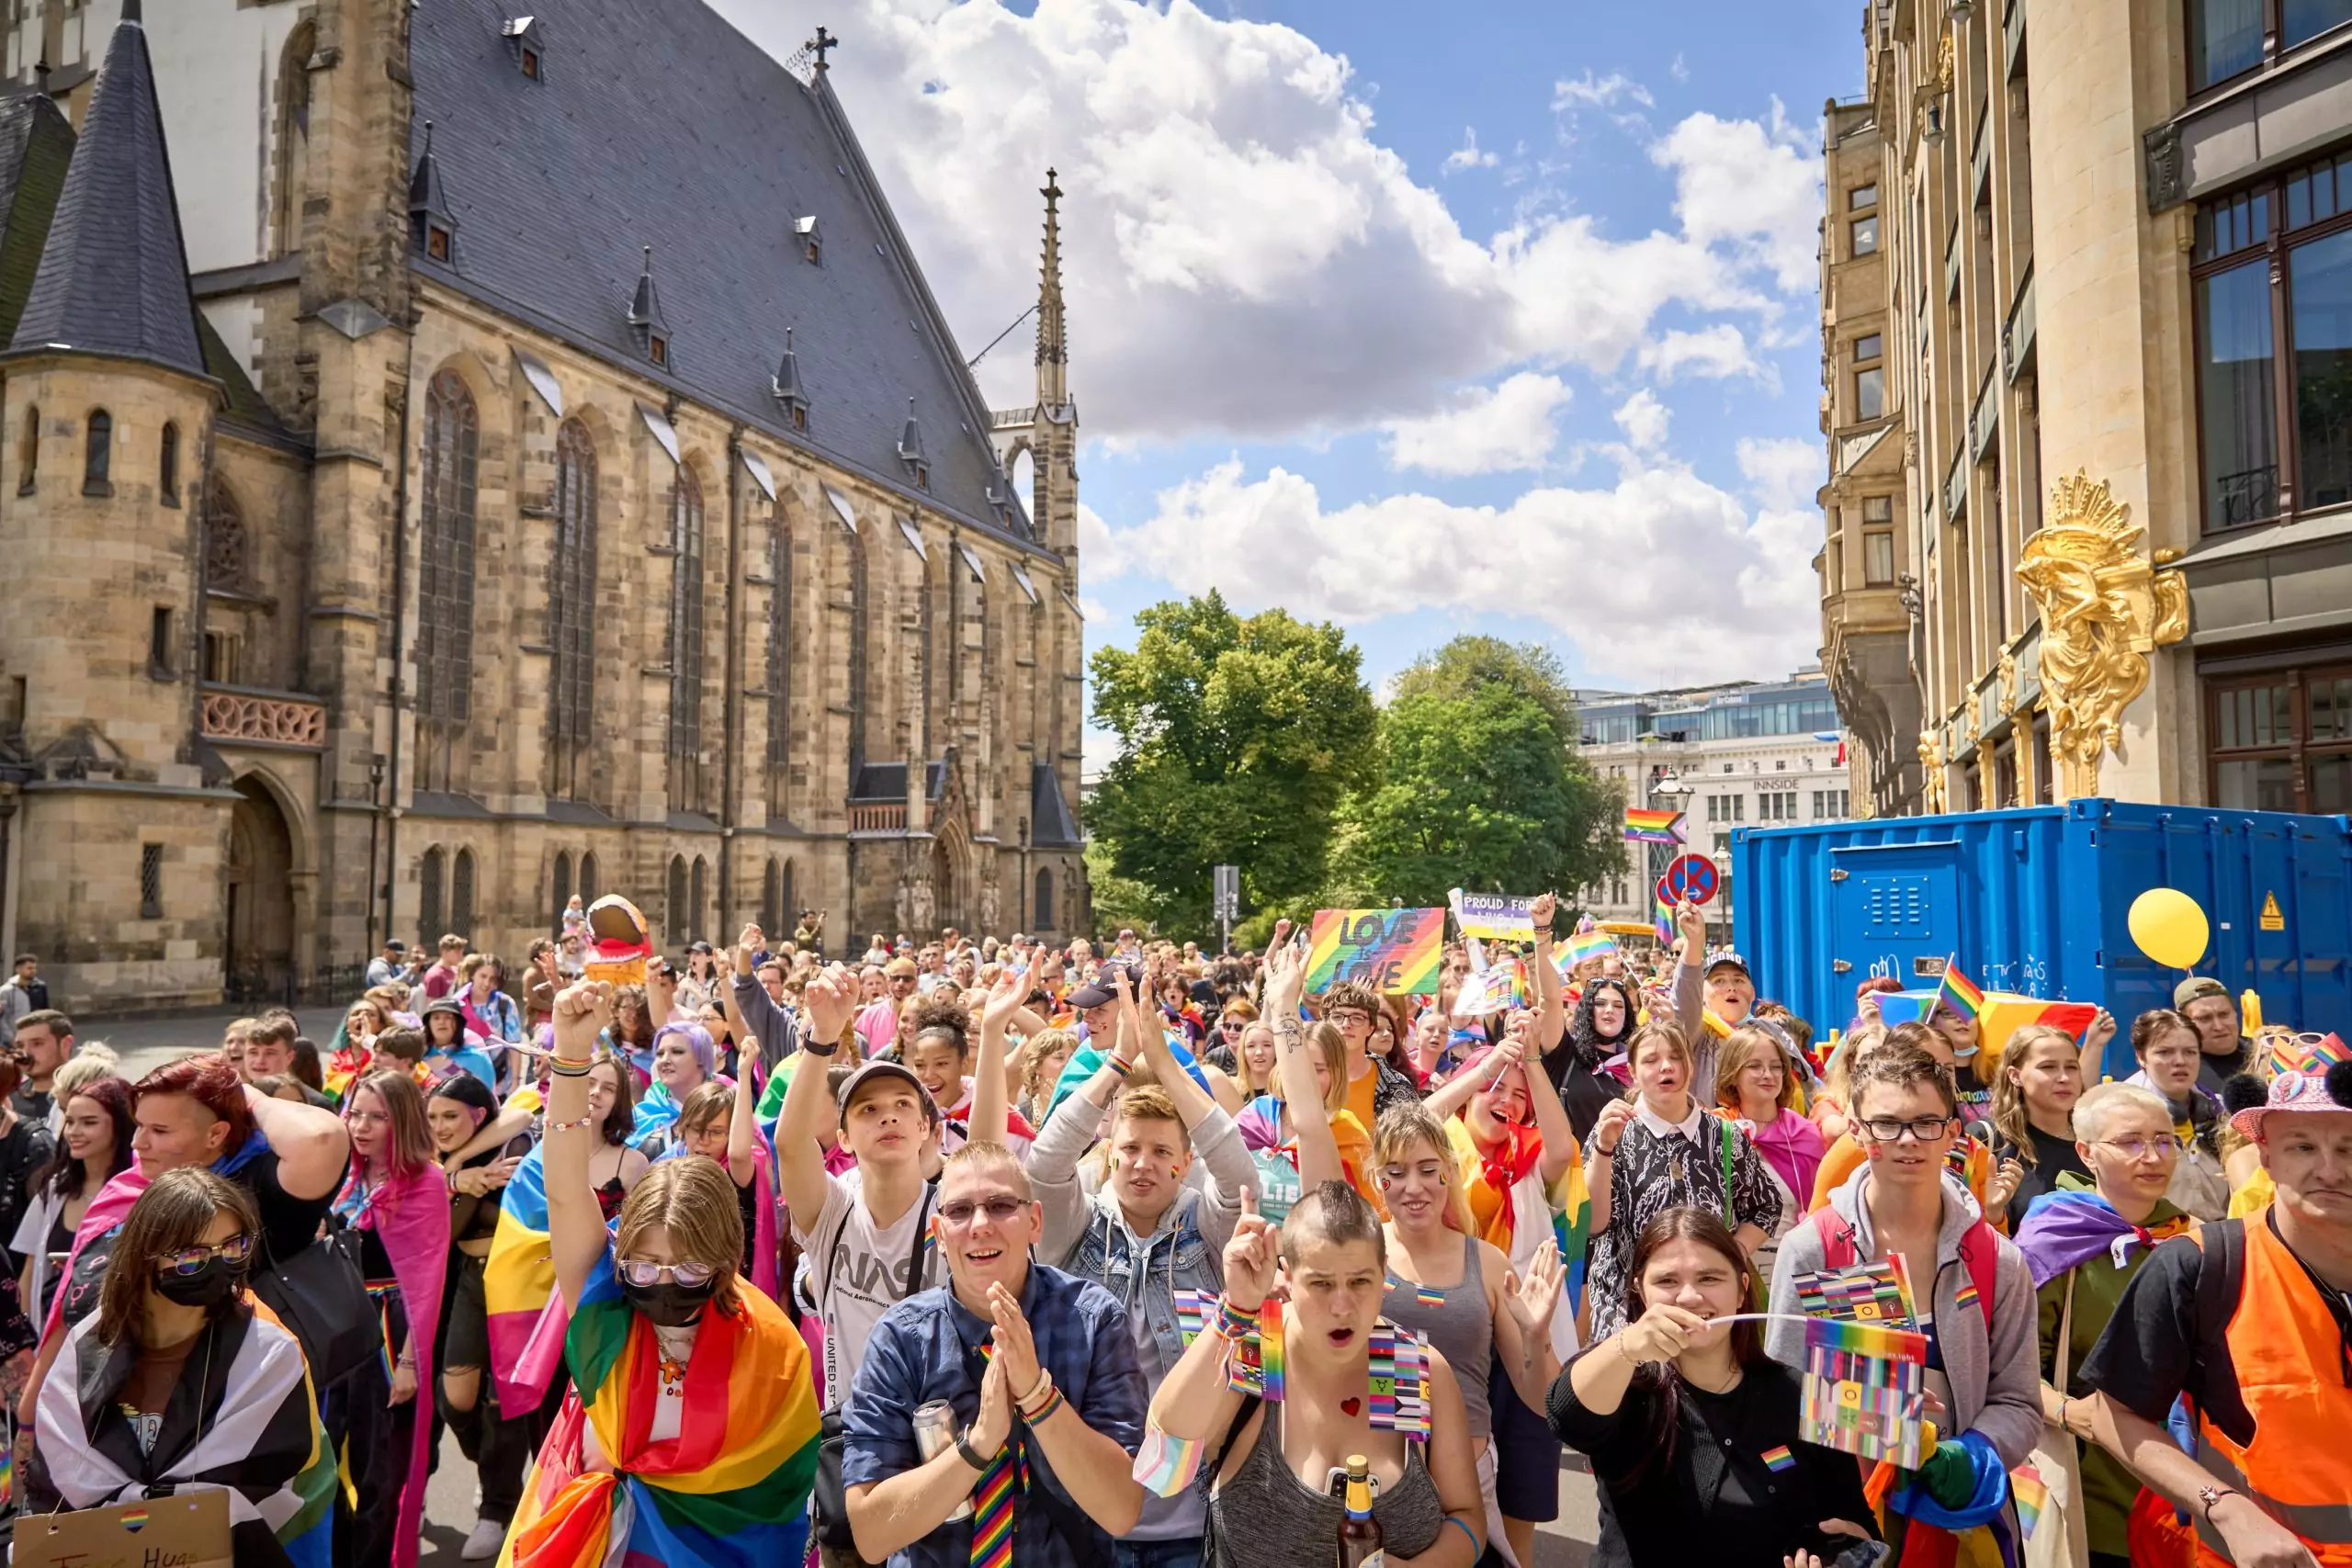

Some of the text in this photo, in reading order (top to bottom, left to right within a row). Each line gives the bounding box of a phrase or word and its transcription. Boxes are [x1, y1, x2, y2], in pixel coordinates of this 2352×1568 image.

[1753, 778, 1800, 791] INNSIDE
[1464, 897, 1504, 910] PROUD
[1340, 912, 1419, 947] LOVE
[828, 1337, 837, 1405] UNITED ST
